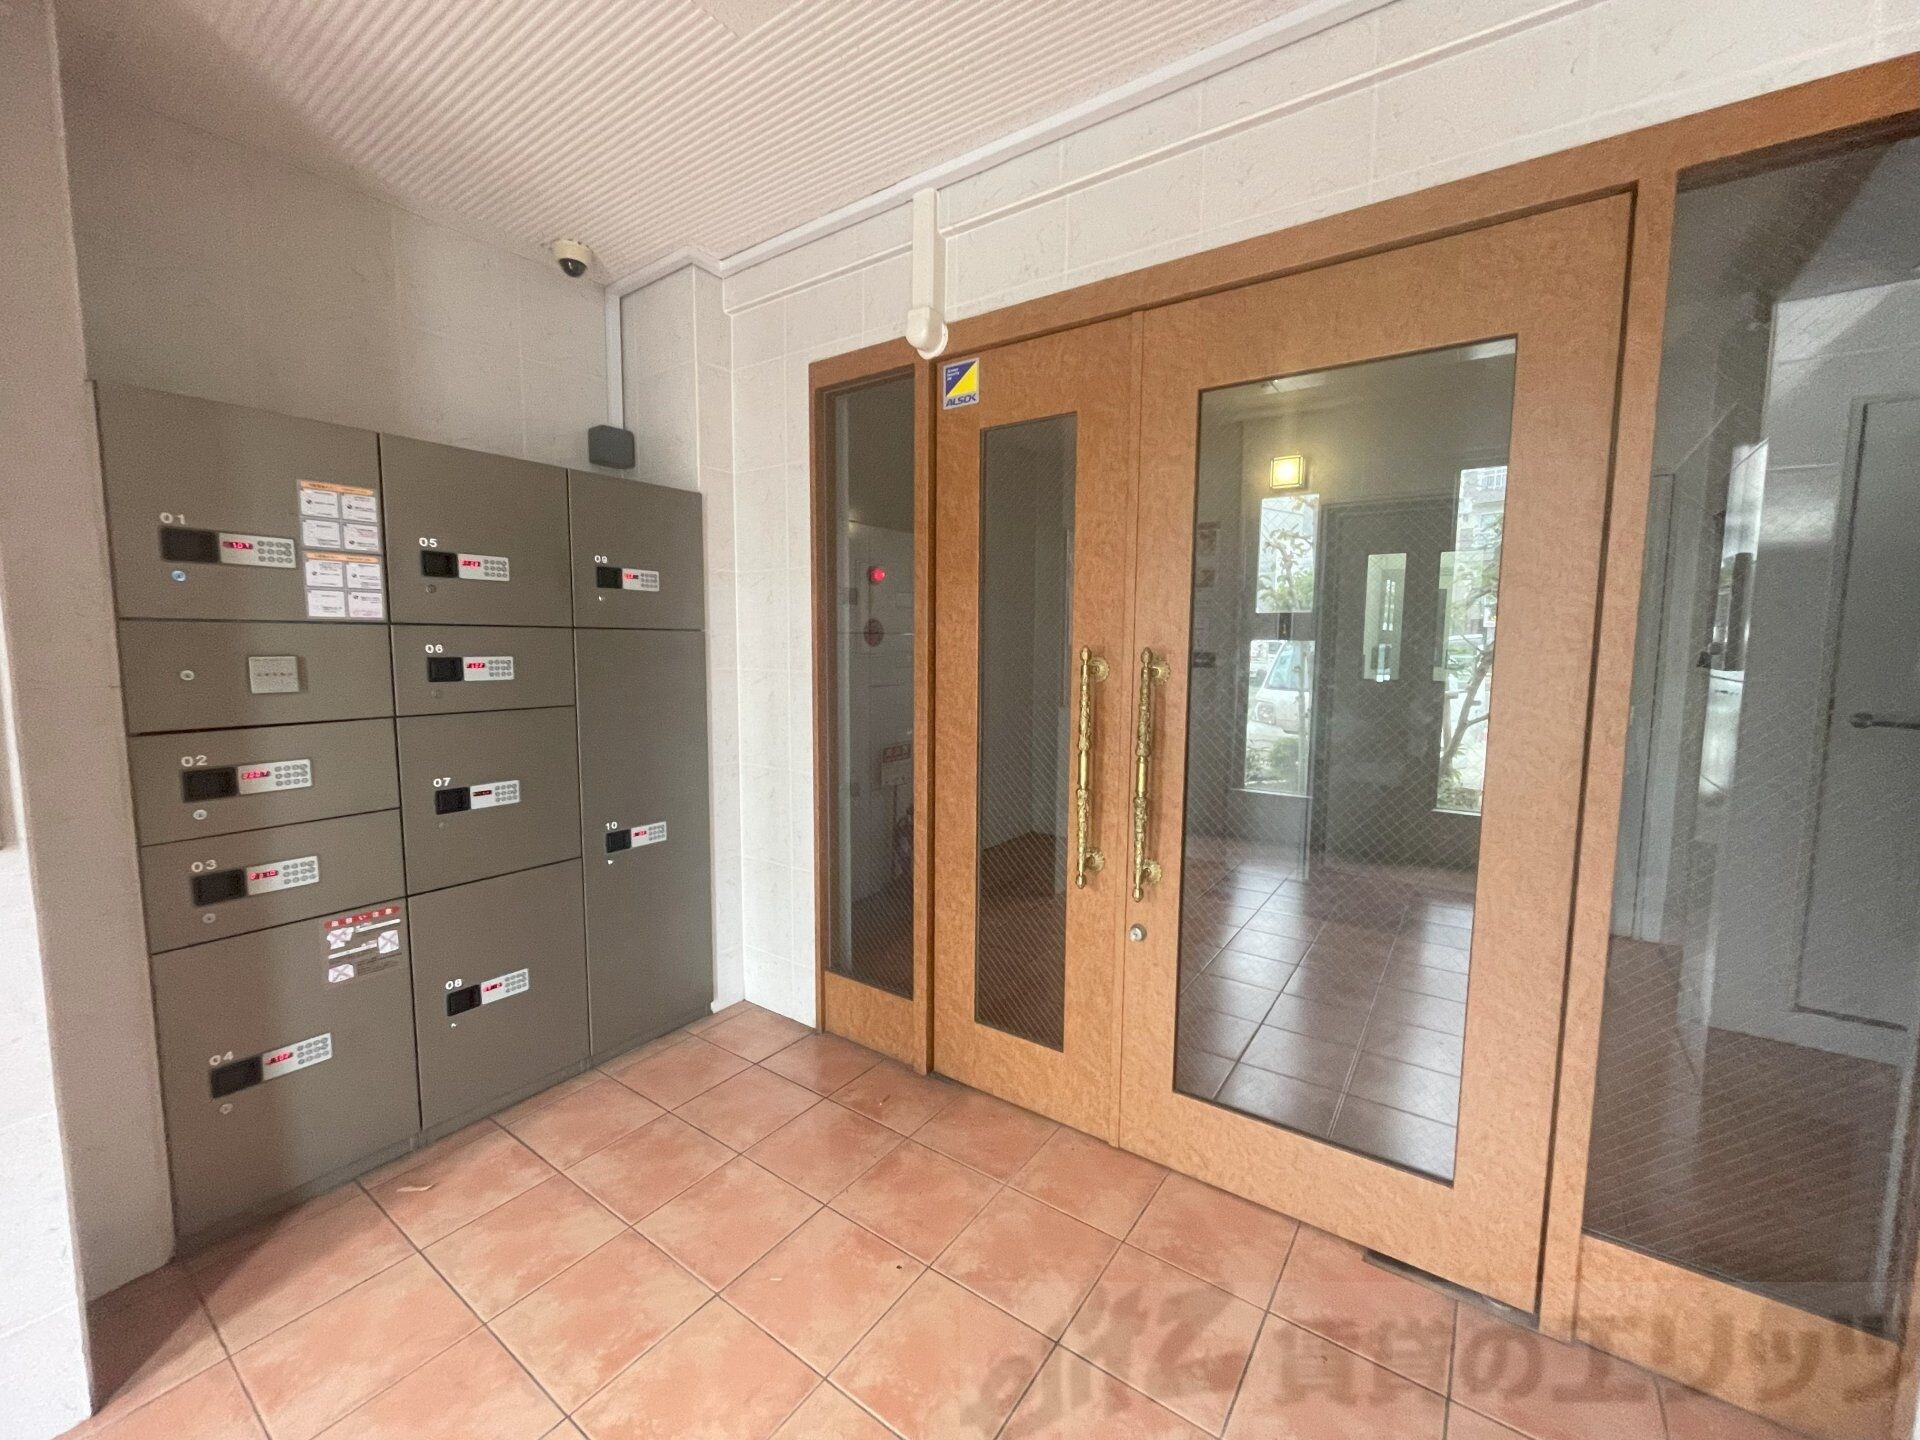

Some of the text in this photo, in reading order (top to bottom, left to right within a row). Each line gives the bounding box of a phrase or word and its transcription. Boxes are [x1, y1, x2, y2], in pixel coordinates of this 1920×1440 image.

[945, 394, 976, 407] ALSOK
[159, 512, 186, 525] 01
[418, 537, 438, 548] 05
[425, 644, 443, 654] 06
[181, 754, 208, 767] 02
[433, 777, 451, 787] 07
[605, 821, 618, 831] 10
[191, 859, 217, 873] 03
[445, 978, 463, 990] 08
[209, 1051, 235, 1066] 04
